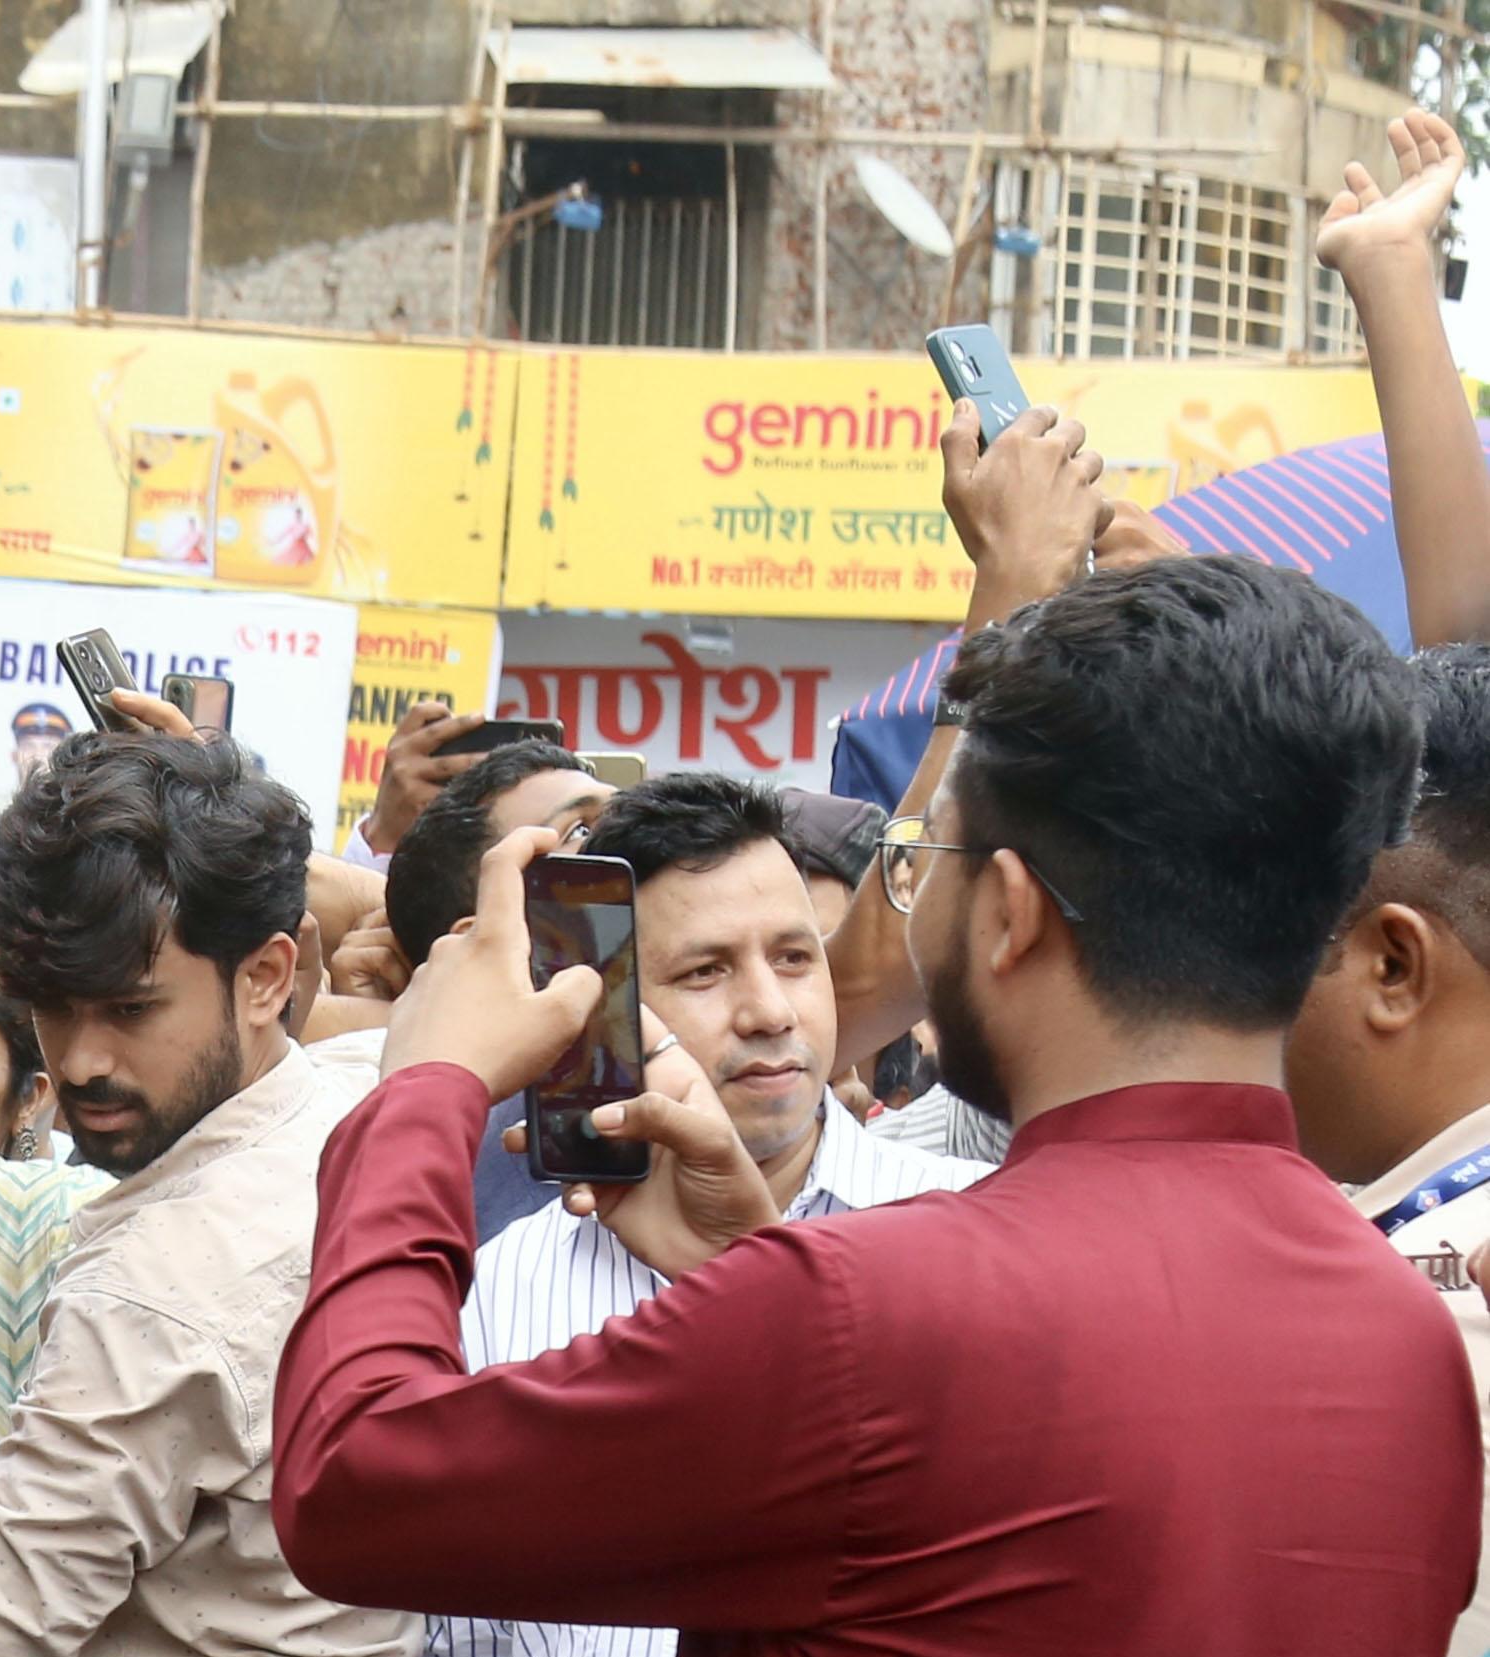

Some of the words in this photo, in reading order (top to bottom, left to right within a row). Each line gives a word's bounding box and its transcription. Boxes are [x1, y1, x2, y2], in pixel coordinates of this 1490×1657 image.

[702, 388, 943, 477] gemini
[711, 490, 814, 542] गणेश
[829, 507, 949, 546] उत्सव
[651, 554, 700, 587] No.1
[266, 628, 322, 658] 112
[496, 631, 831, 771] गणेश
